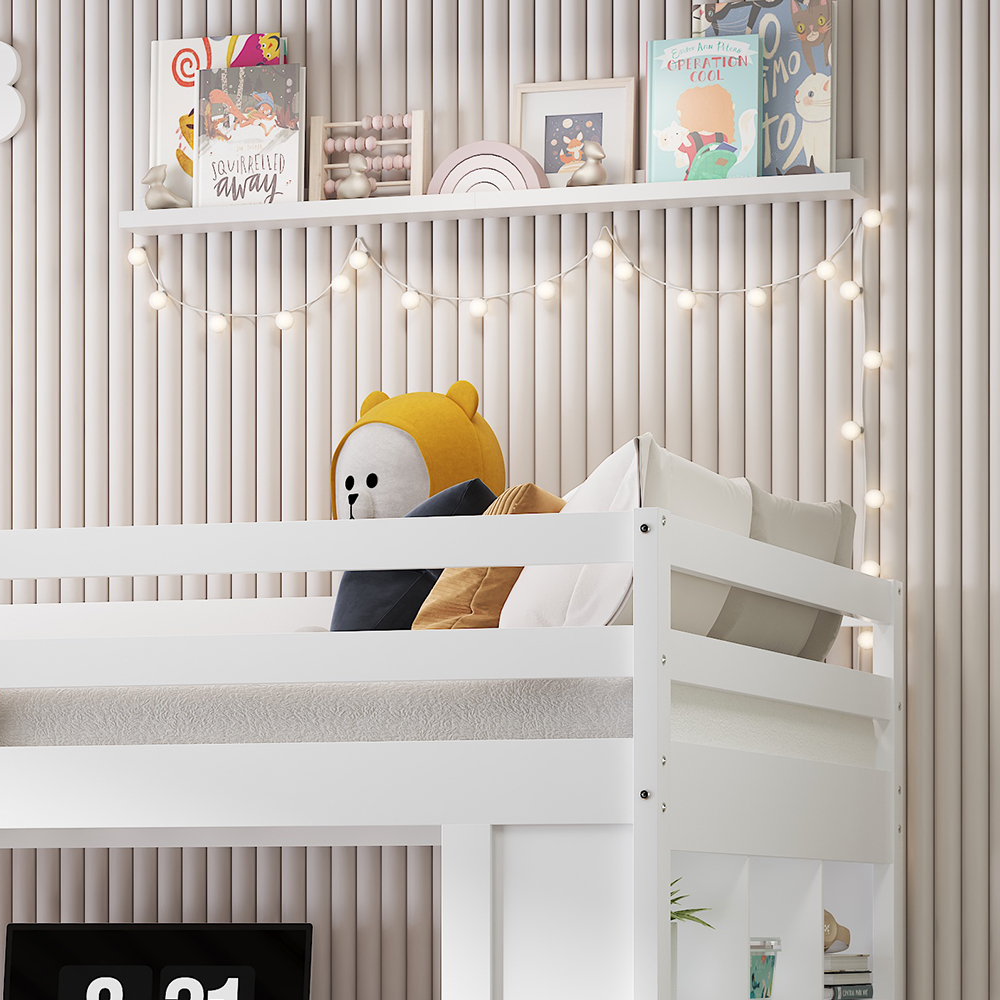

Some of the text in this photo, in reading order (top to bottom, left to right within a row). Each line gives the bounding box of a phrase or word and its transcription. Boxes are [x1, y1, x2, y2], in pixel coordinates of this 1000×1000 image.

[667, 55, 748, 71] OPERATION
[690, 69, 724, 82] COOL
[211, 152, 285, 181] SQUIRRELLED
[213, 173, 283, 204] away
